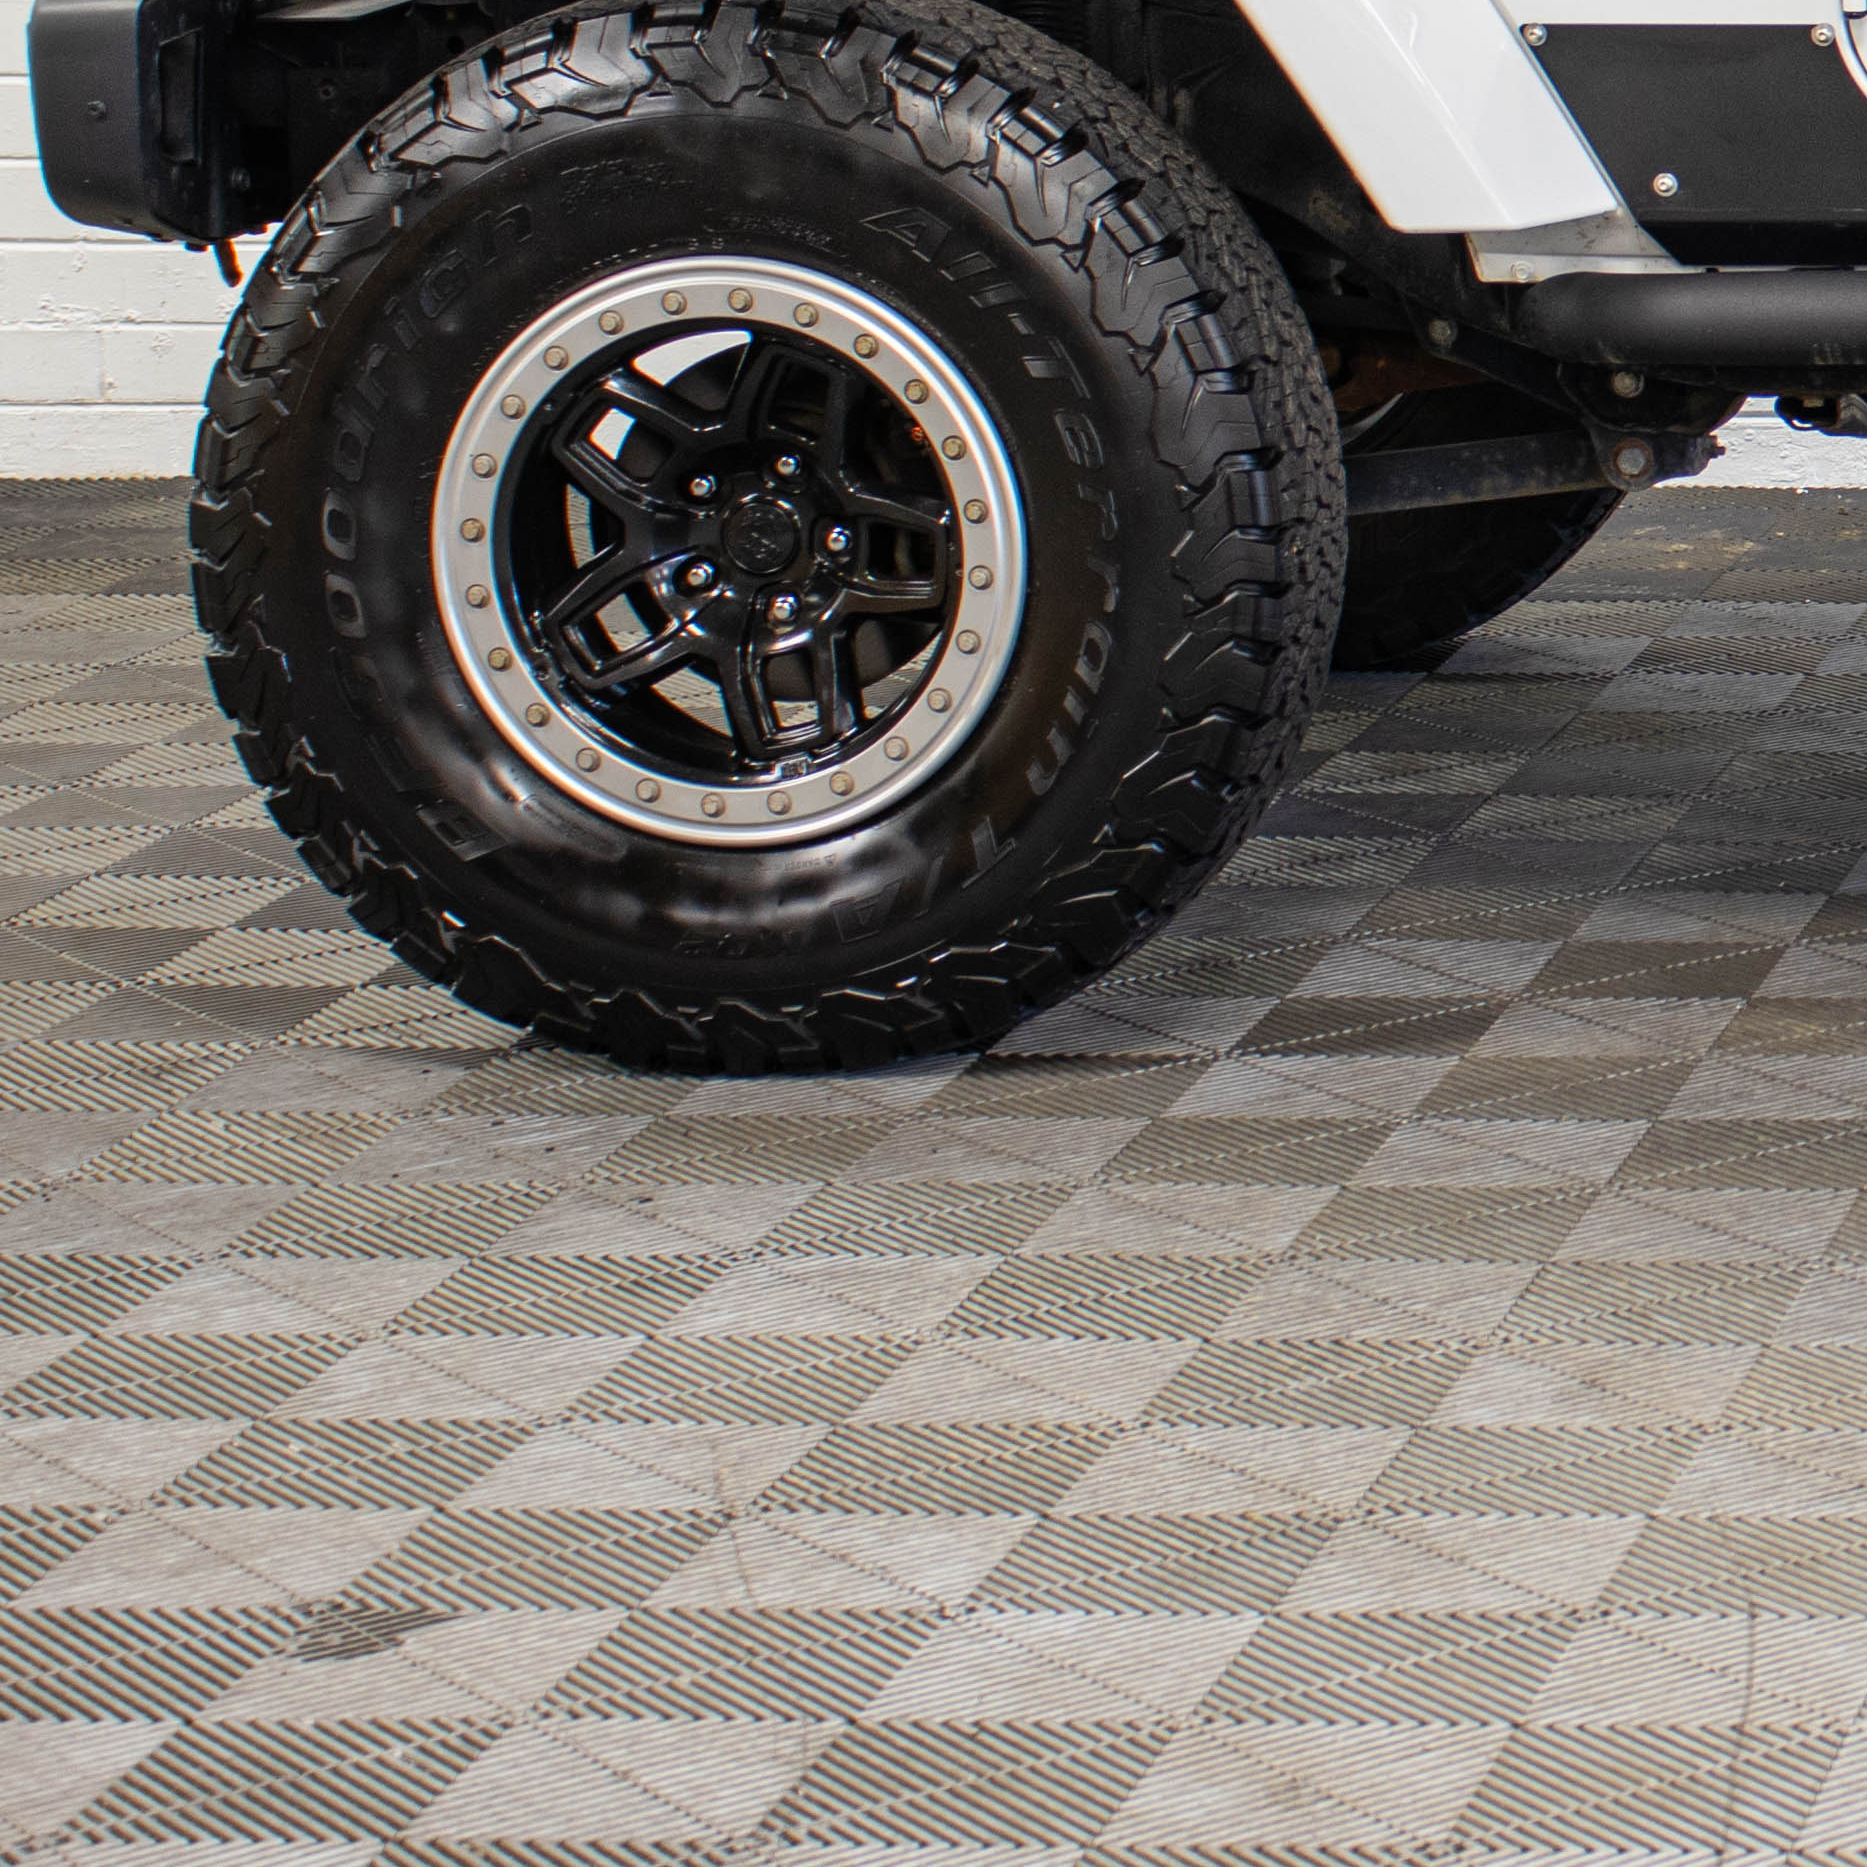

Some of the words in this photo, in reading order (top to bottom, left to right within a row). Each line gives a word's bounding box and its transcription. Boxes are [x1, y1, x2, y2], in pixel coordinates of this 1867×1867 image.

[321, 200, 534, 862] BFGoodrich
[860, 206, 1119, 797] All-Terrain
[829, 814, 1017, 944] T/A
